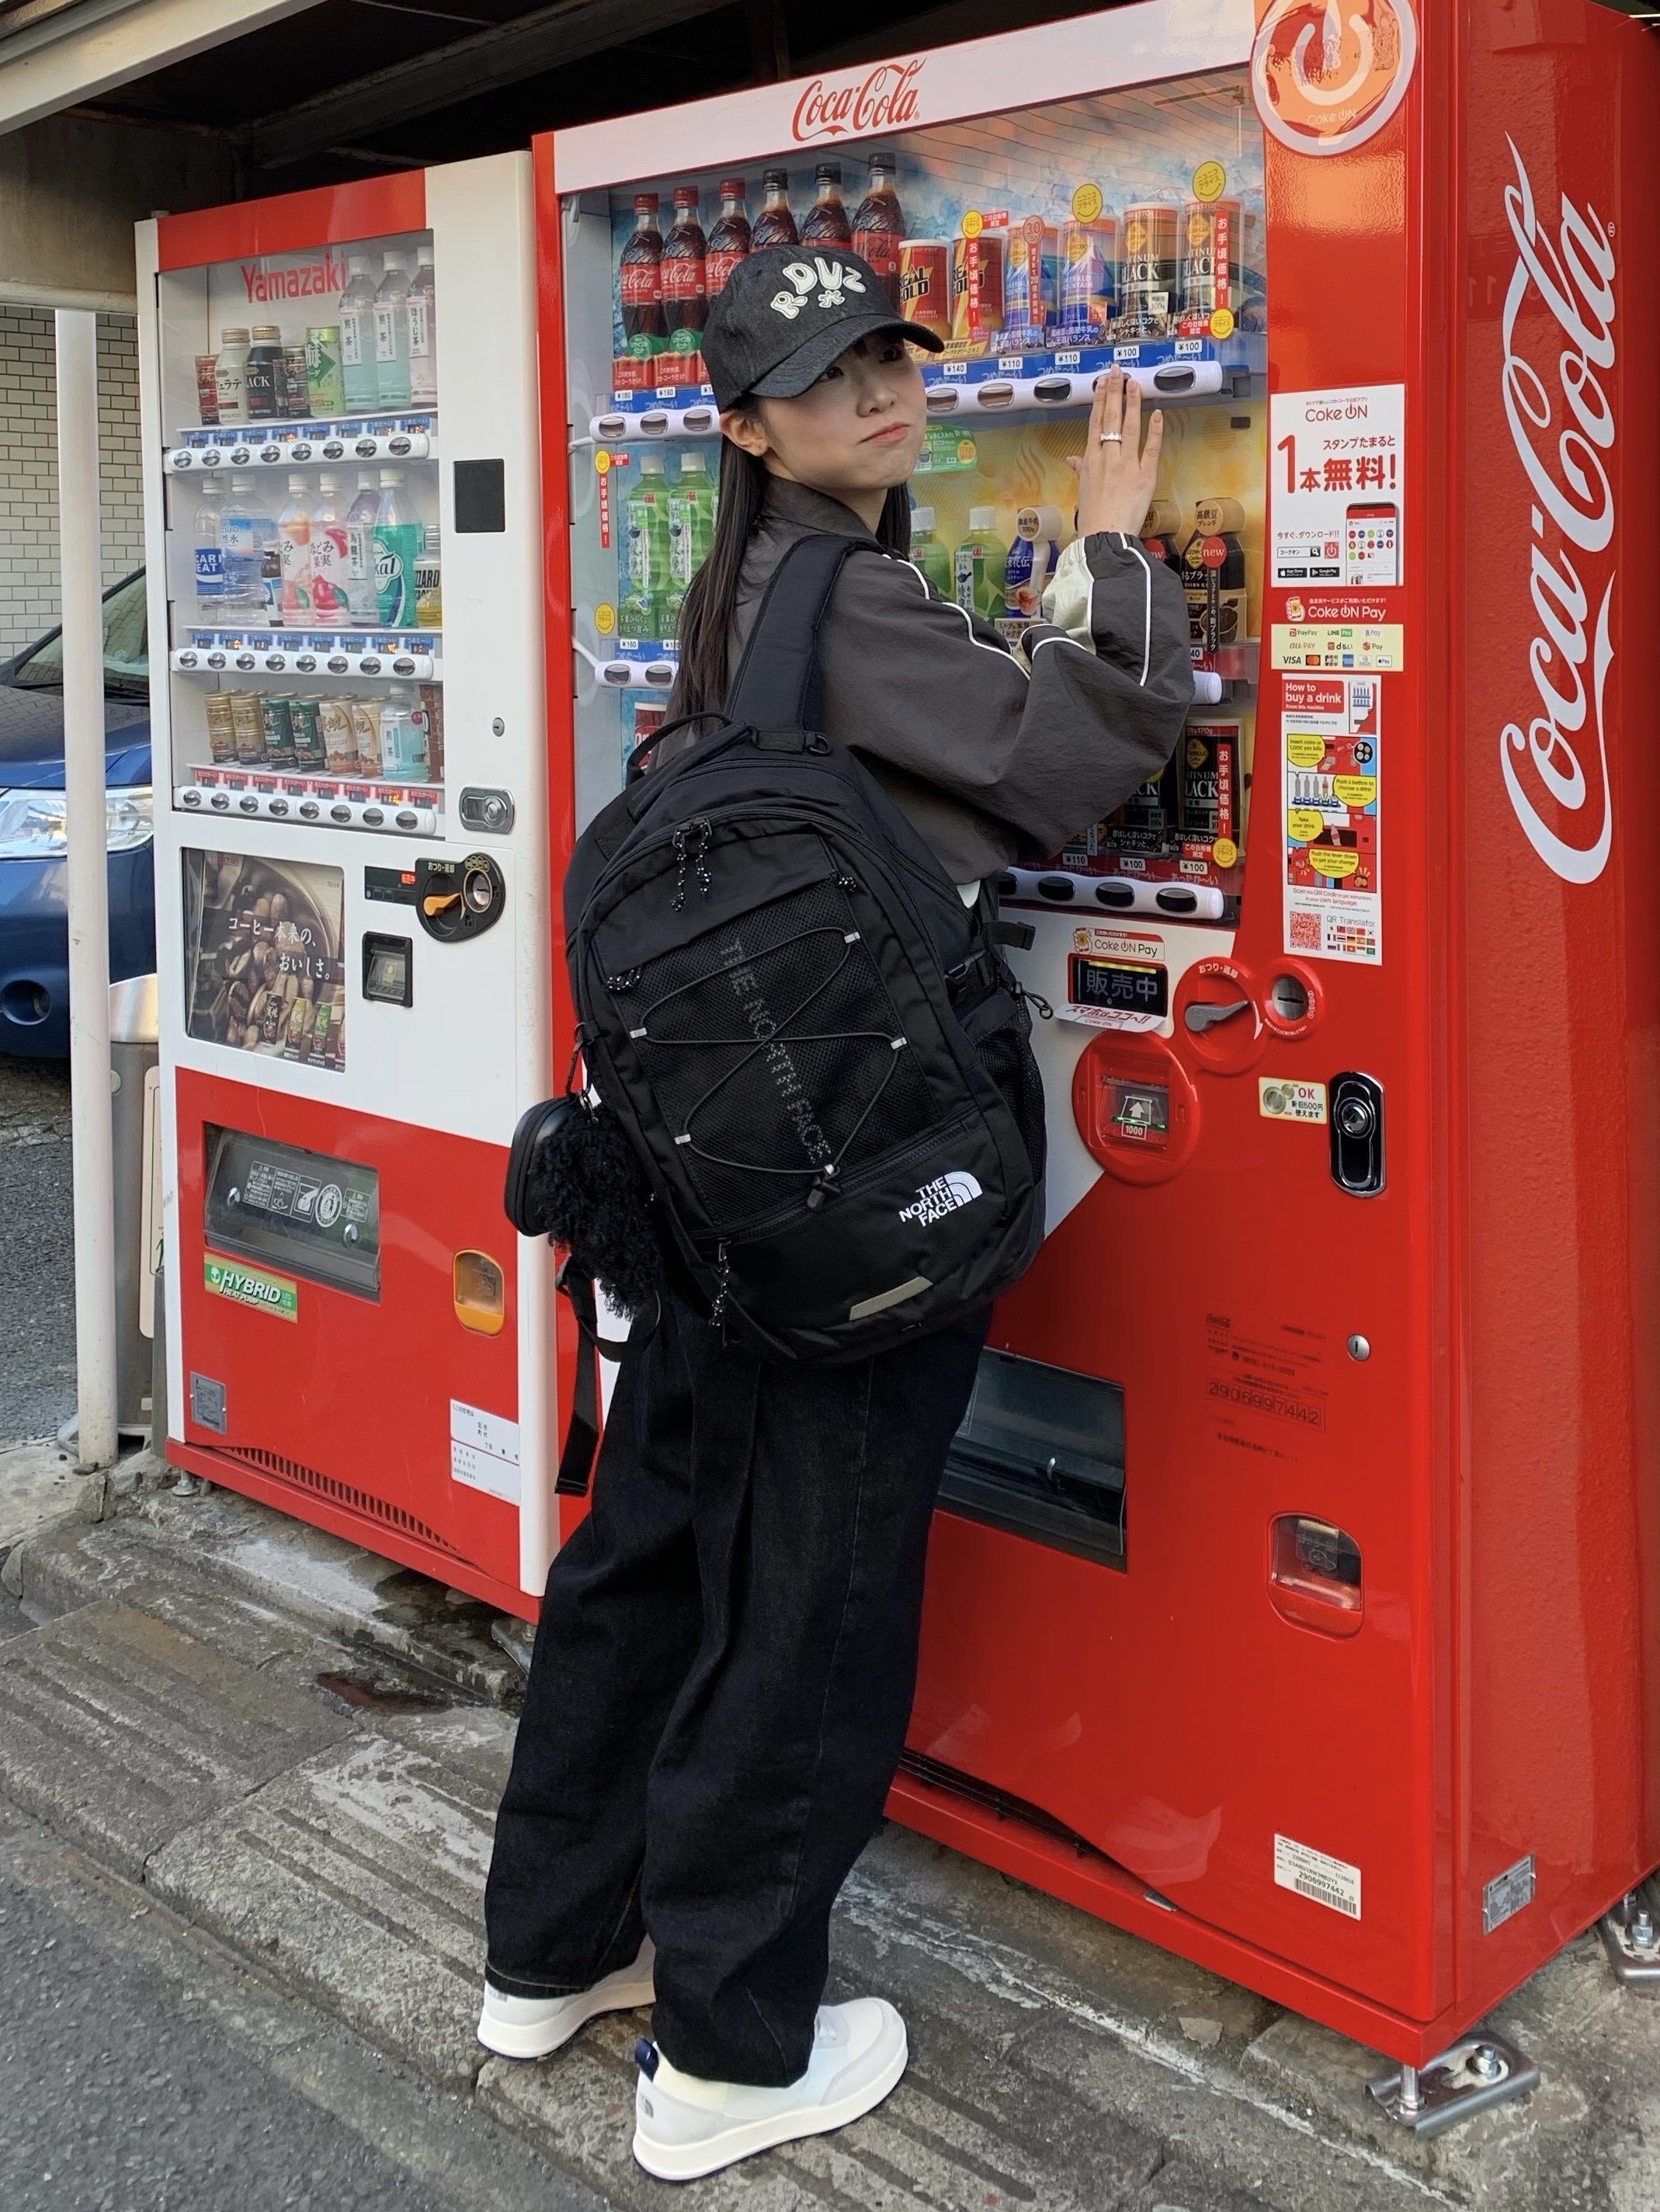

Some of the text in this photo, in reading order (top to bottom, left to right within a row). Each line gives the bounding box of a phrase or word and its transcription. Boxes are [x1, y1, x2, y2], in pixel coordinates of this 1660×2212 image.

[792, 57, 927, 141] Coca-Cola
[240, 250, 347, 304] Yamazaki
[1117, 348, 1137, 357] ¥100
[1179, 342, 1200, 351] ¥100
[1002, 359, 1021, 369] ¥110
[1058, 354, 1078, 363] ¥110
[946, 365, 965, 373] ¥140
[617, 391, 631, 400] ¥180
[1305, 403, 1368, 422] Coke ON
[1323, 435, 1396, 450] スタンプたまると
[1500, 131, 1617, 884] Coca-Cola
[1196, 509, 1217, 520] 高級豆
[1203, 547, 1225, 557] new
[1308, 604, 1387, 622] Coke ON Pay
[1297, 629, 1318, 637] PayPay
[1282, 655, 1302, 665] VISA
[1285, 682, 1317, 693] How to
[1285, 691, 1305, 704] buy
[1315, 692, 1342, 704] drink
[1219, 750, 1230, 834] お手頃価格！
[1065, 856, 1085, 865] ¥110
[1123, 860, 1144, 870] ¥100
[1182, 863, 1204, 873] ¥100
[1326, 915, 1376, 927] QR Translator
[1094, 939, 1158, 958] Coke ON Pay
[279, 952, 331, 981] おいしさ。
[1086, 968, 1158, 1003] 販売中
[1298, 1087, 1315, 1099] OK
[1291, 1100, 1324, 1111] 新旧500円
[1295, 1109, 1320, 1119] 使えます
[1125, 1125, 1144, 1137] 1000
[915, 1175, 947, 1199] THE
[898, 1186, 953, 1223] NORTH
[918, 1197, 957, 1227] FACE
[219, 1270, 281, 1304] HYBRID
[1207, 1380, 1321, 1426] 2906997442
